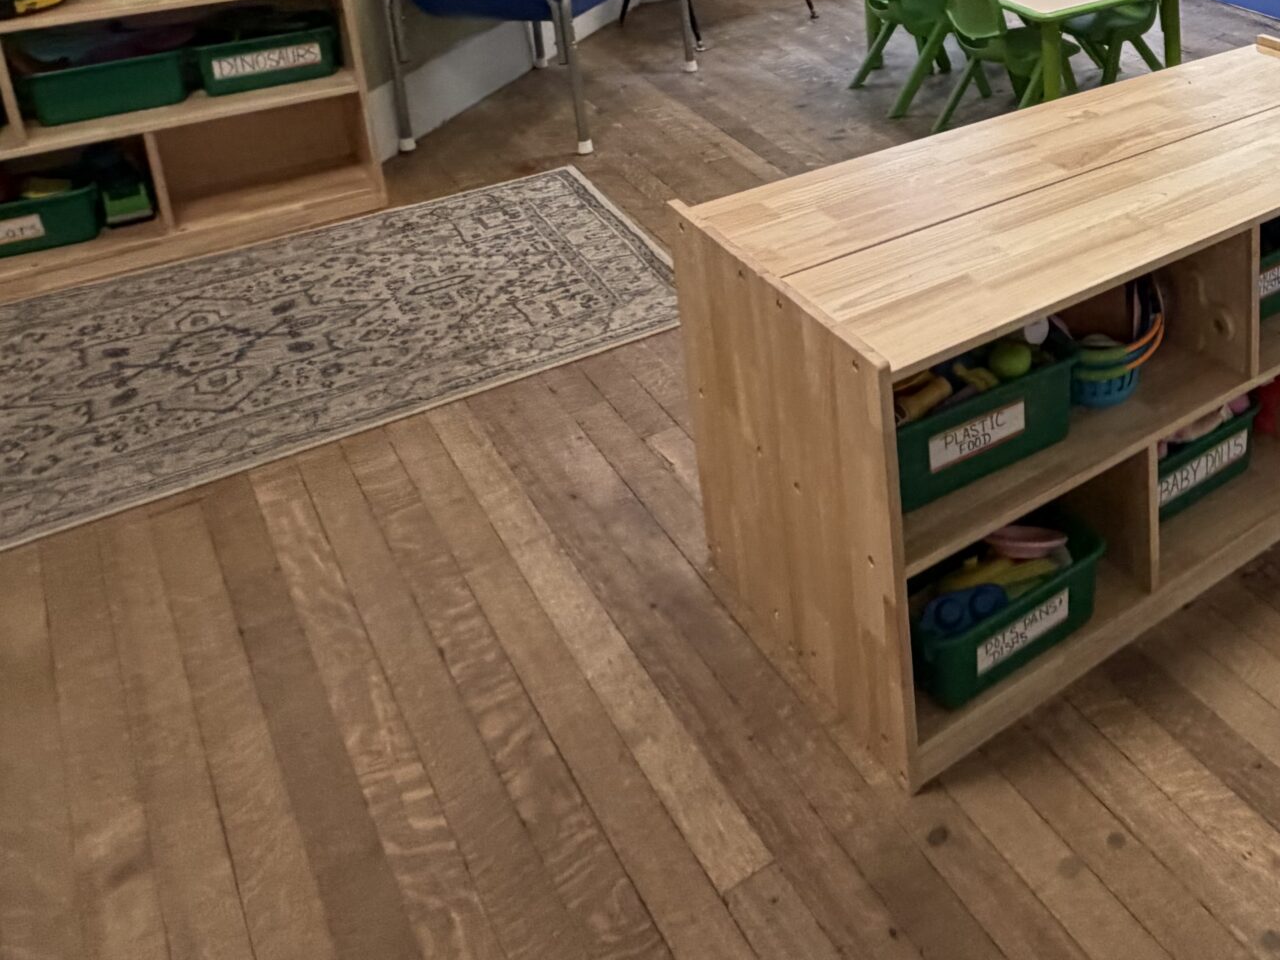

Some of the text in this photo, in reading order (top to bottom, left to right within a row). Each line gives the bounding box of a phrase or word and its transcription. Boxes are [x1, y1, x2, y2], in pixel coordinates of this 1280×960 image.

[217, 45, 319, 76] DINOSAURS
[944, 411, 1007, 450] PLASTIC
[959, 432, 992, 455] FOOD
